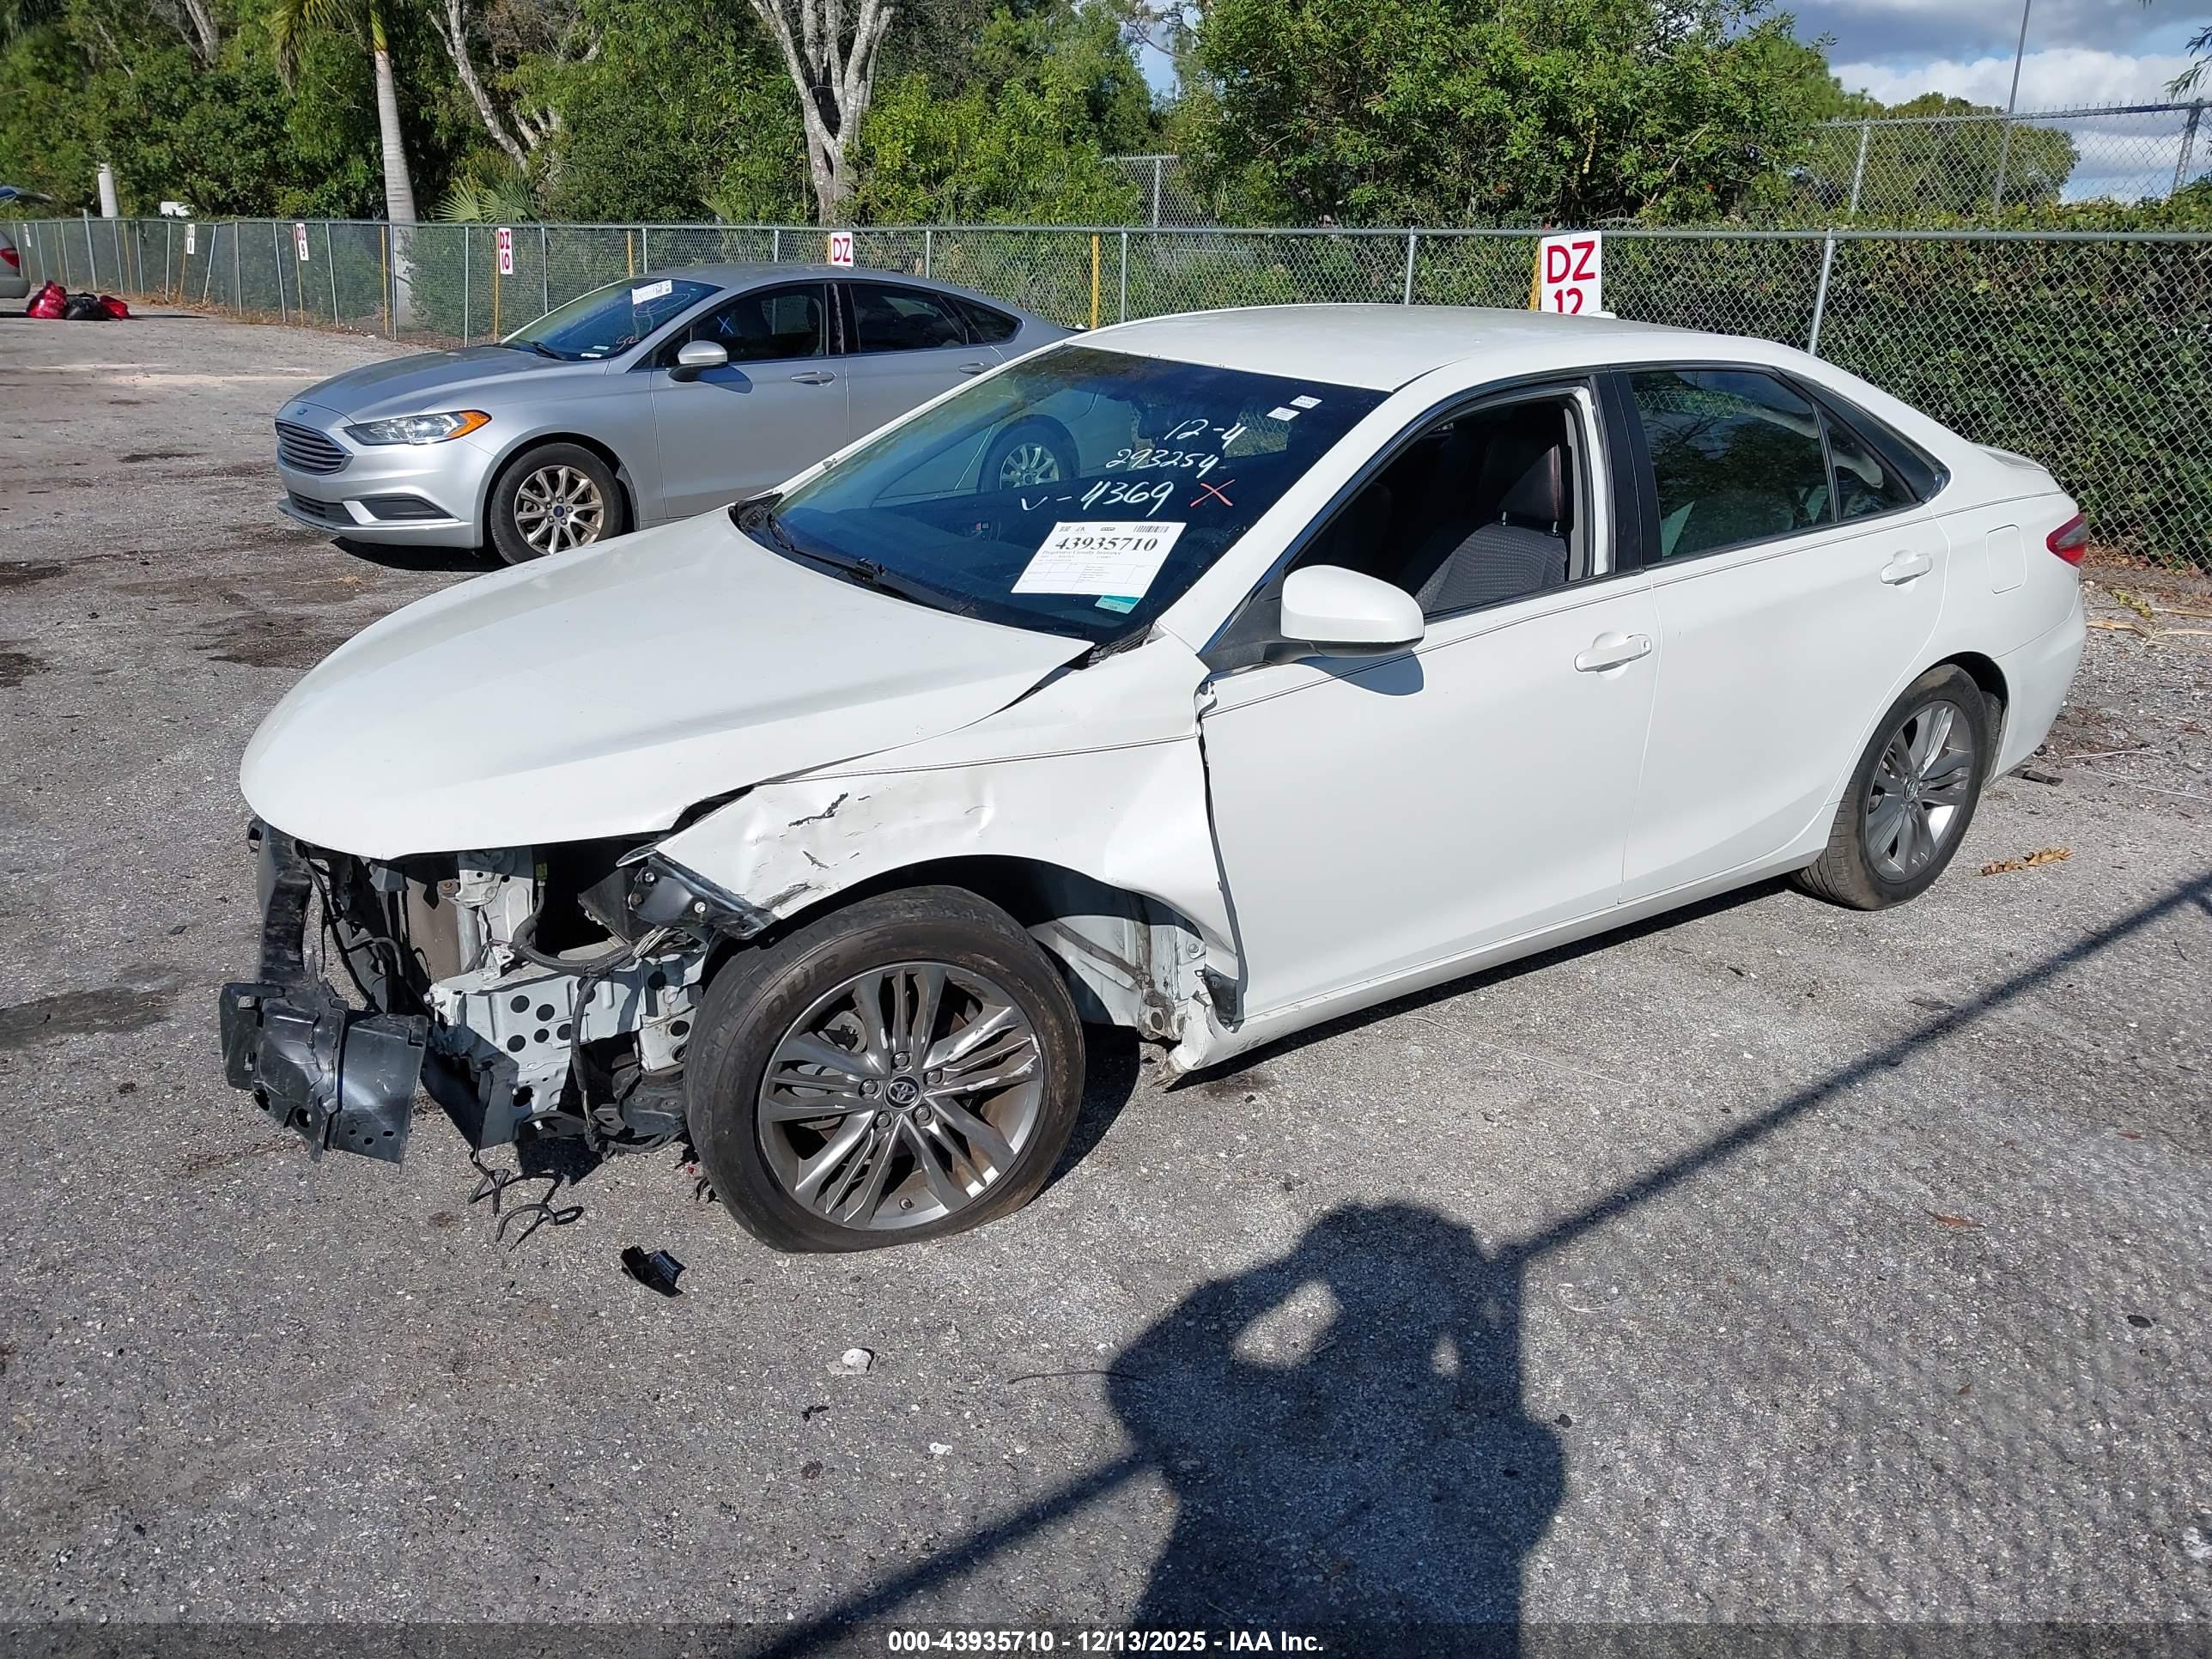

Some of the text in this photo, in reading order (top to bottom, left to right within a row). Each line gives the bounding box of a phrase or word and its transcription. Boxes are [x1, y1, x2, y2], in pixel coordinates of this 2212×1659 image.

[296, 226, 306, 241] DZ
[499, 231, 510, 250] DZ
[301, 242, 307, 258] 9
[833, 237, 851, 263] DZ
[501, 252, 510, 270] 10
[1547, 240, 1595, 284] DZ
[1553, 287, 1583, 314] 12
[1105, 447, 1220, 479] 293254
[1054, 537, 1158, 551] 43935710
